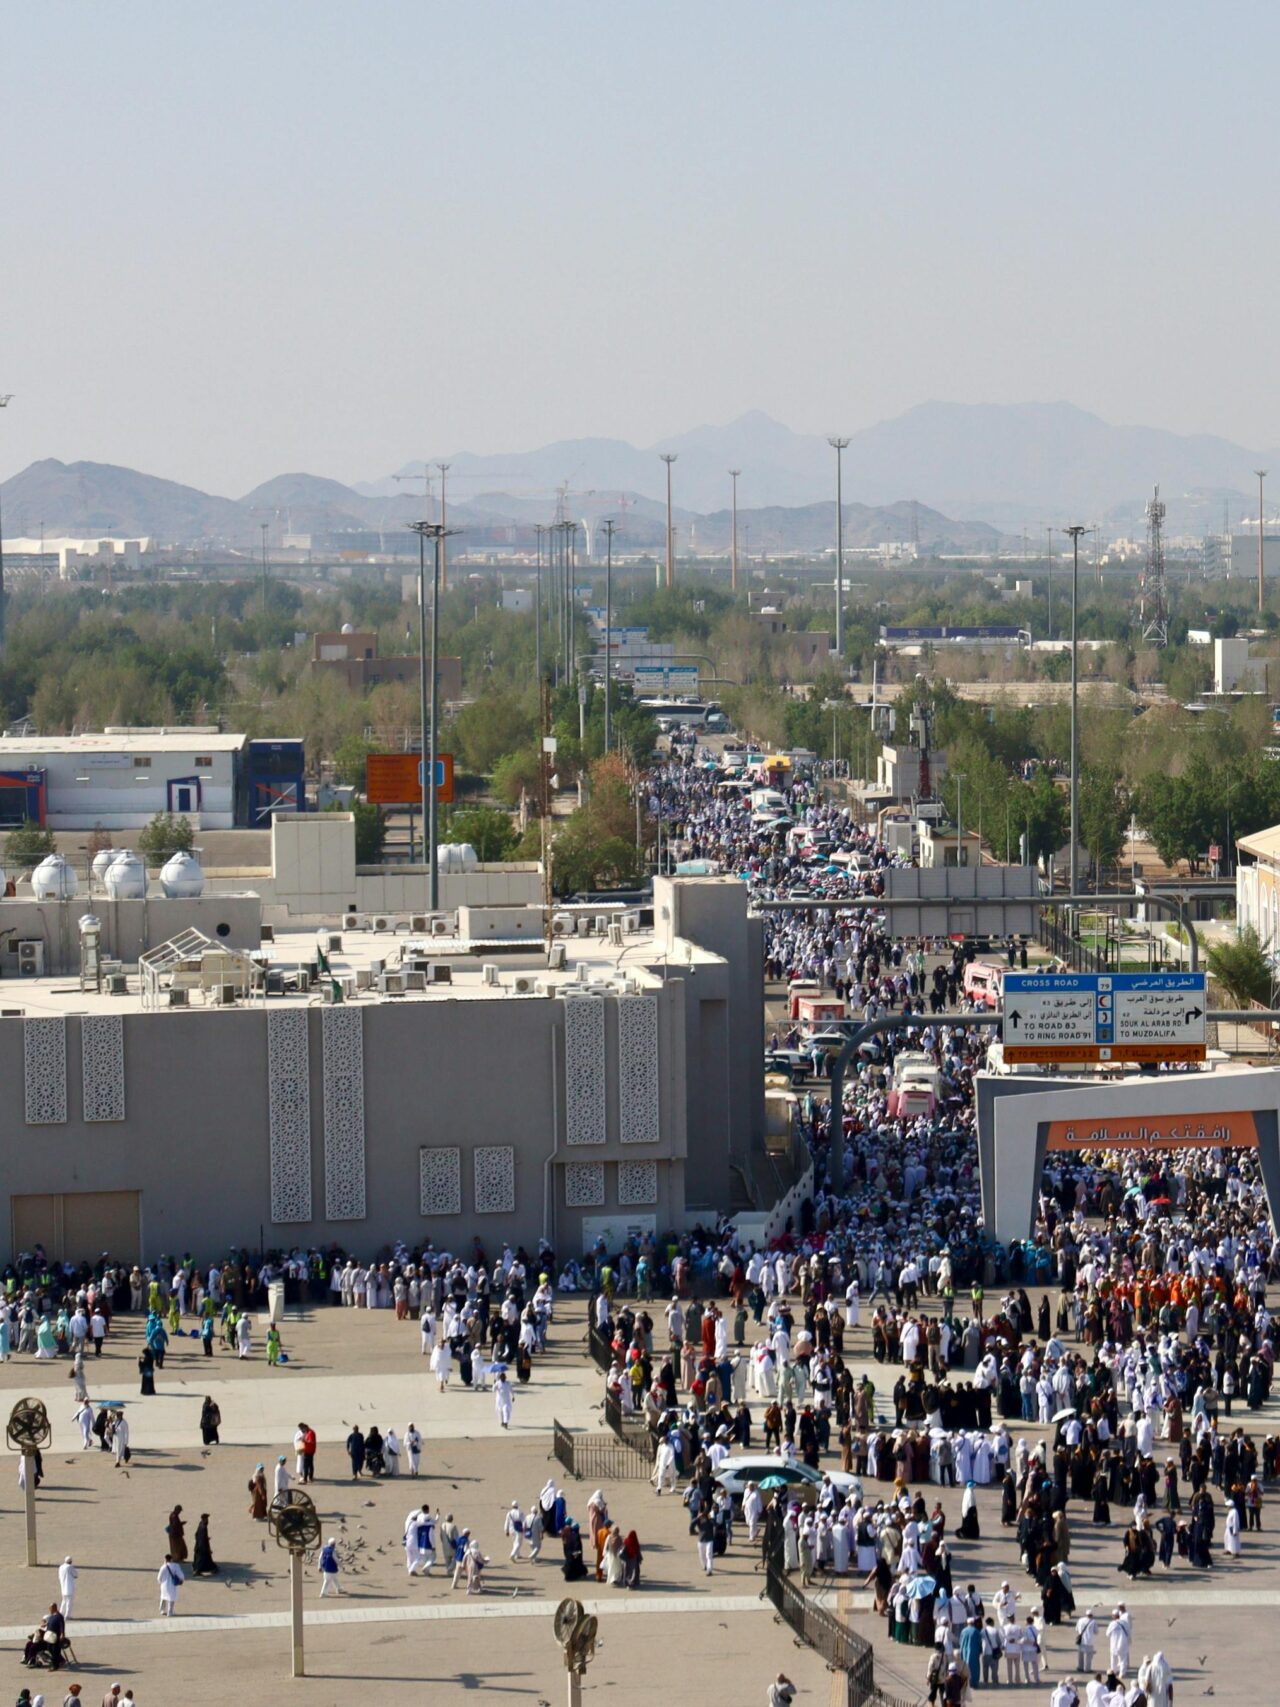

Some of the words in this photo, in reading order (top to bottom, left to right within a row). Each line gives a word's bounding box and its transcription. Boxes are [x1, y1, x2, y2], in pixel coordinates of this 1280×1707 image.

[1021, 979, 1051, 987] CROSS
[1054, 979, 1079, 987] ROAD
[1131, 978, 1164, 991] العرضي
[1164, 977, 1195, 989] الطريق
[1053, 997, 1077, 1008] طريق
[1079, 998, 1093, 1008] إلى
[1126, 993, 1148, 1003] العرب
[1149, 994, 1164, 1004] سوق
[1166, 994, 1184, 1004] طريق
[1061, 1010, 1082, 1020] الطريق
[1082, 1010, 1093, 1020] إلى
[1143, 1006, 1170, 1016] مزدلفة
[1172, 1007, 1185, 1018] إلى
[1024, 1022, 1036, 1030] TO
[1038, 1022, 1063, 1030] ROAD
[1065, 1022, 1077, 1030] 83
[1120, 1020, 1139, 1028] SOUK
[1140, 1020, 1150, 1028] AL
[1151, 1020, 1171, 1028] ARAB
[1024, 1032, 1036, 1040] TO
[1037, 1032, 1056, 1040] RING
[1058, 1032, 1081, 1040] ROAD
[1081, 1032, 1092, 1040] 91
[1120, 1030, 1131, 1038] TO
[1132, 1030, 1176, 1038] MUZDALIFA
[1066, 1126, 1148, 1142] السلامة
[1150, 1123, 1231, 1143] رافقتكم
